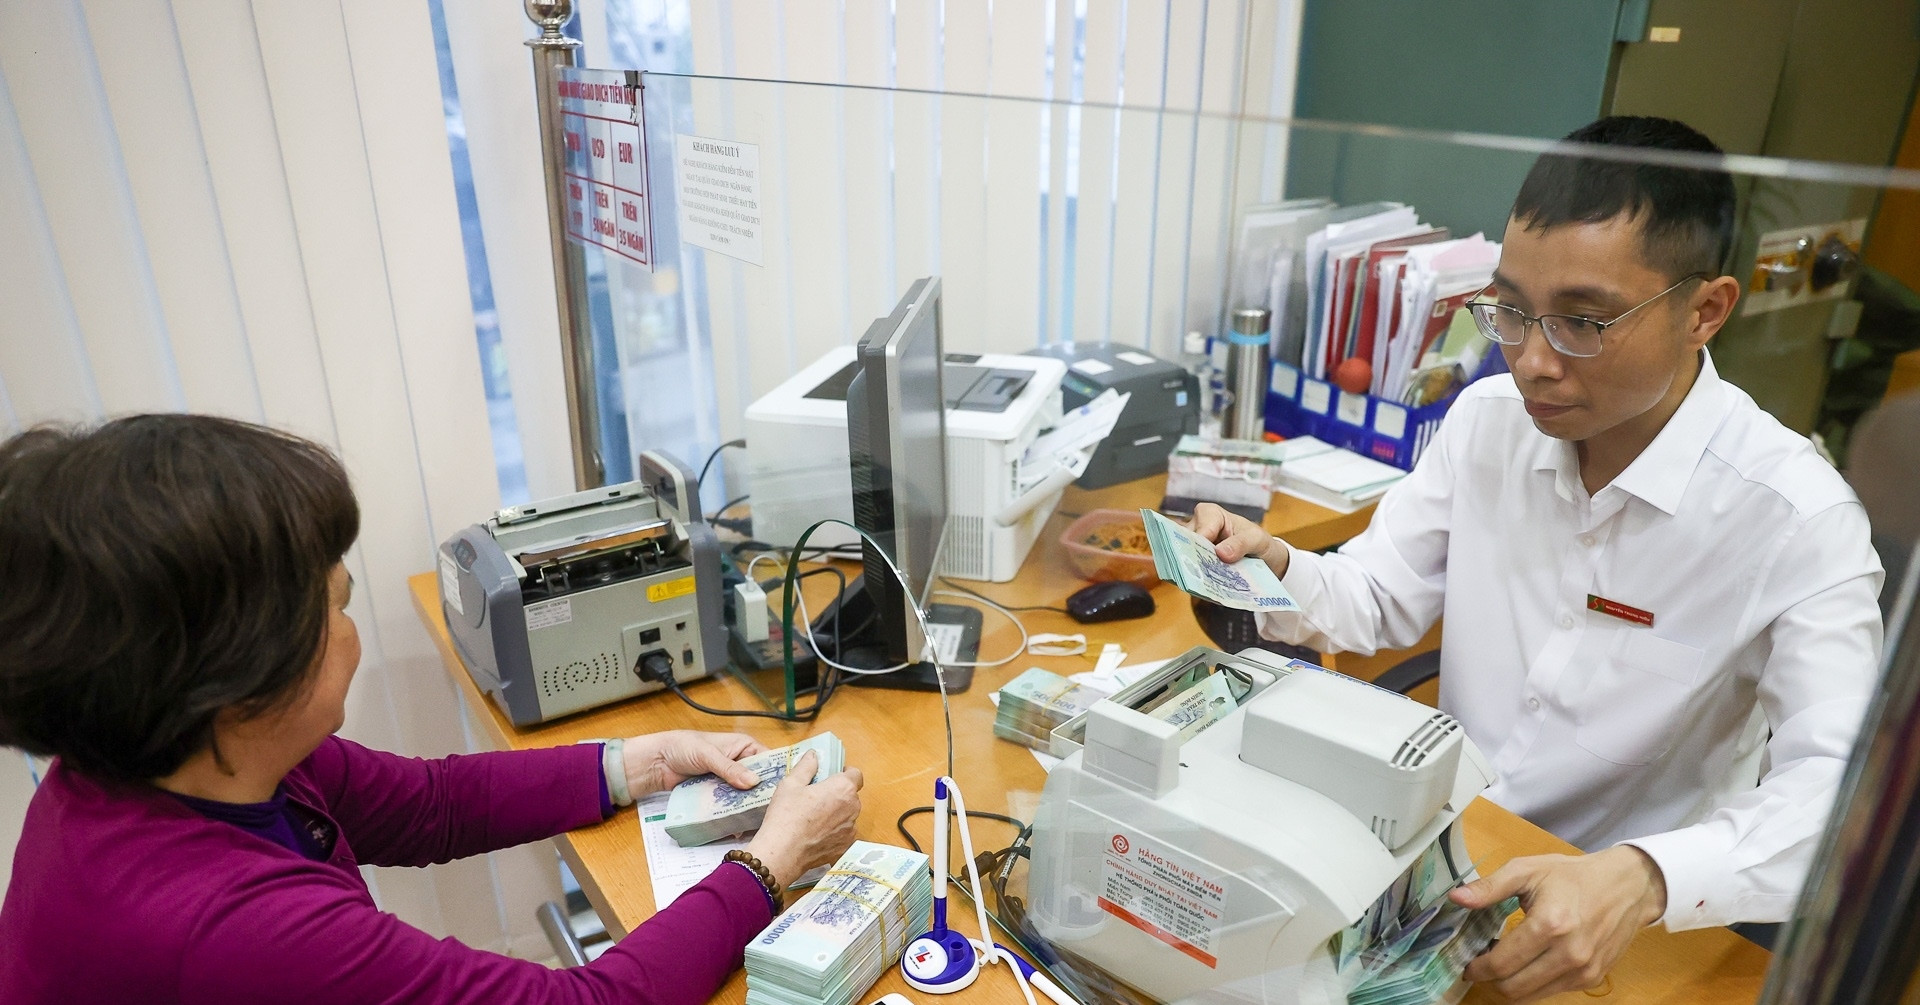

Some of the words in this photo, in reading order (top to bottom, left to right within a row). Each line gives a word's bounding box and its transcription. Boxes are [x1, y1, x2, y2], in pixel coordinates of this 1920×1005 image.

[592, 138, 604, 158] USD
[618, 142, 634, 164] EUR
[1253, 597, 1292, 607] 500000
[1138, 847, 1163, 865] HÀNG
[1202, 880, 1223, 894] NAM
[762, 912, 802, 944] 500000
